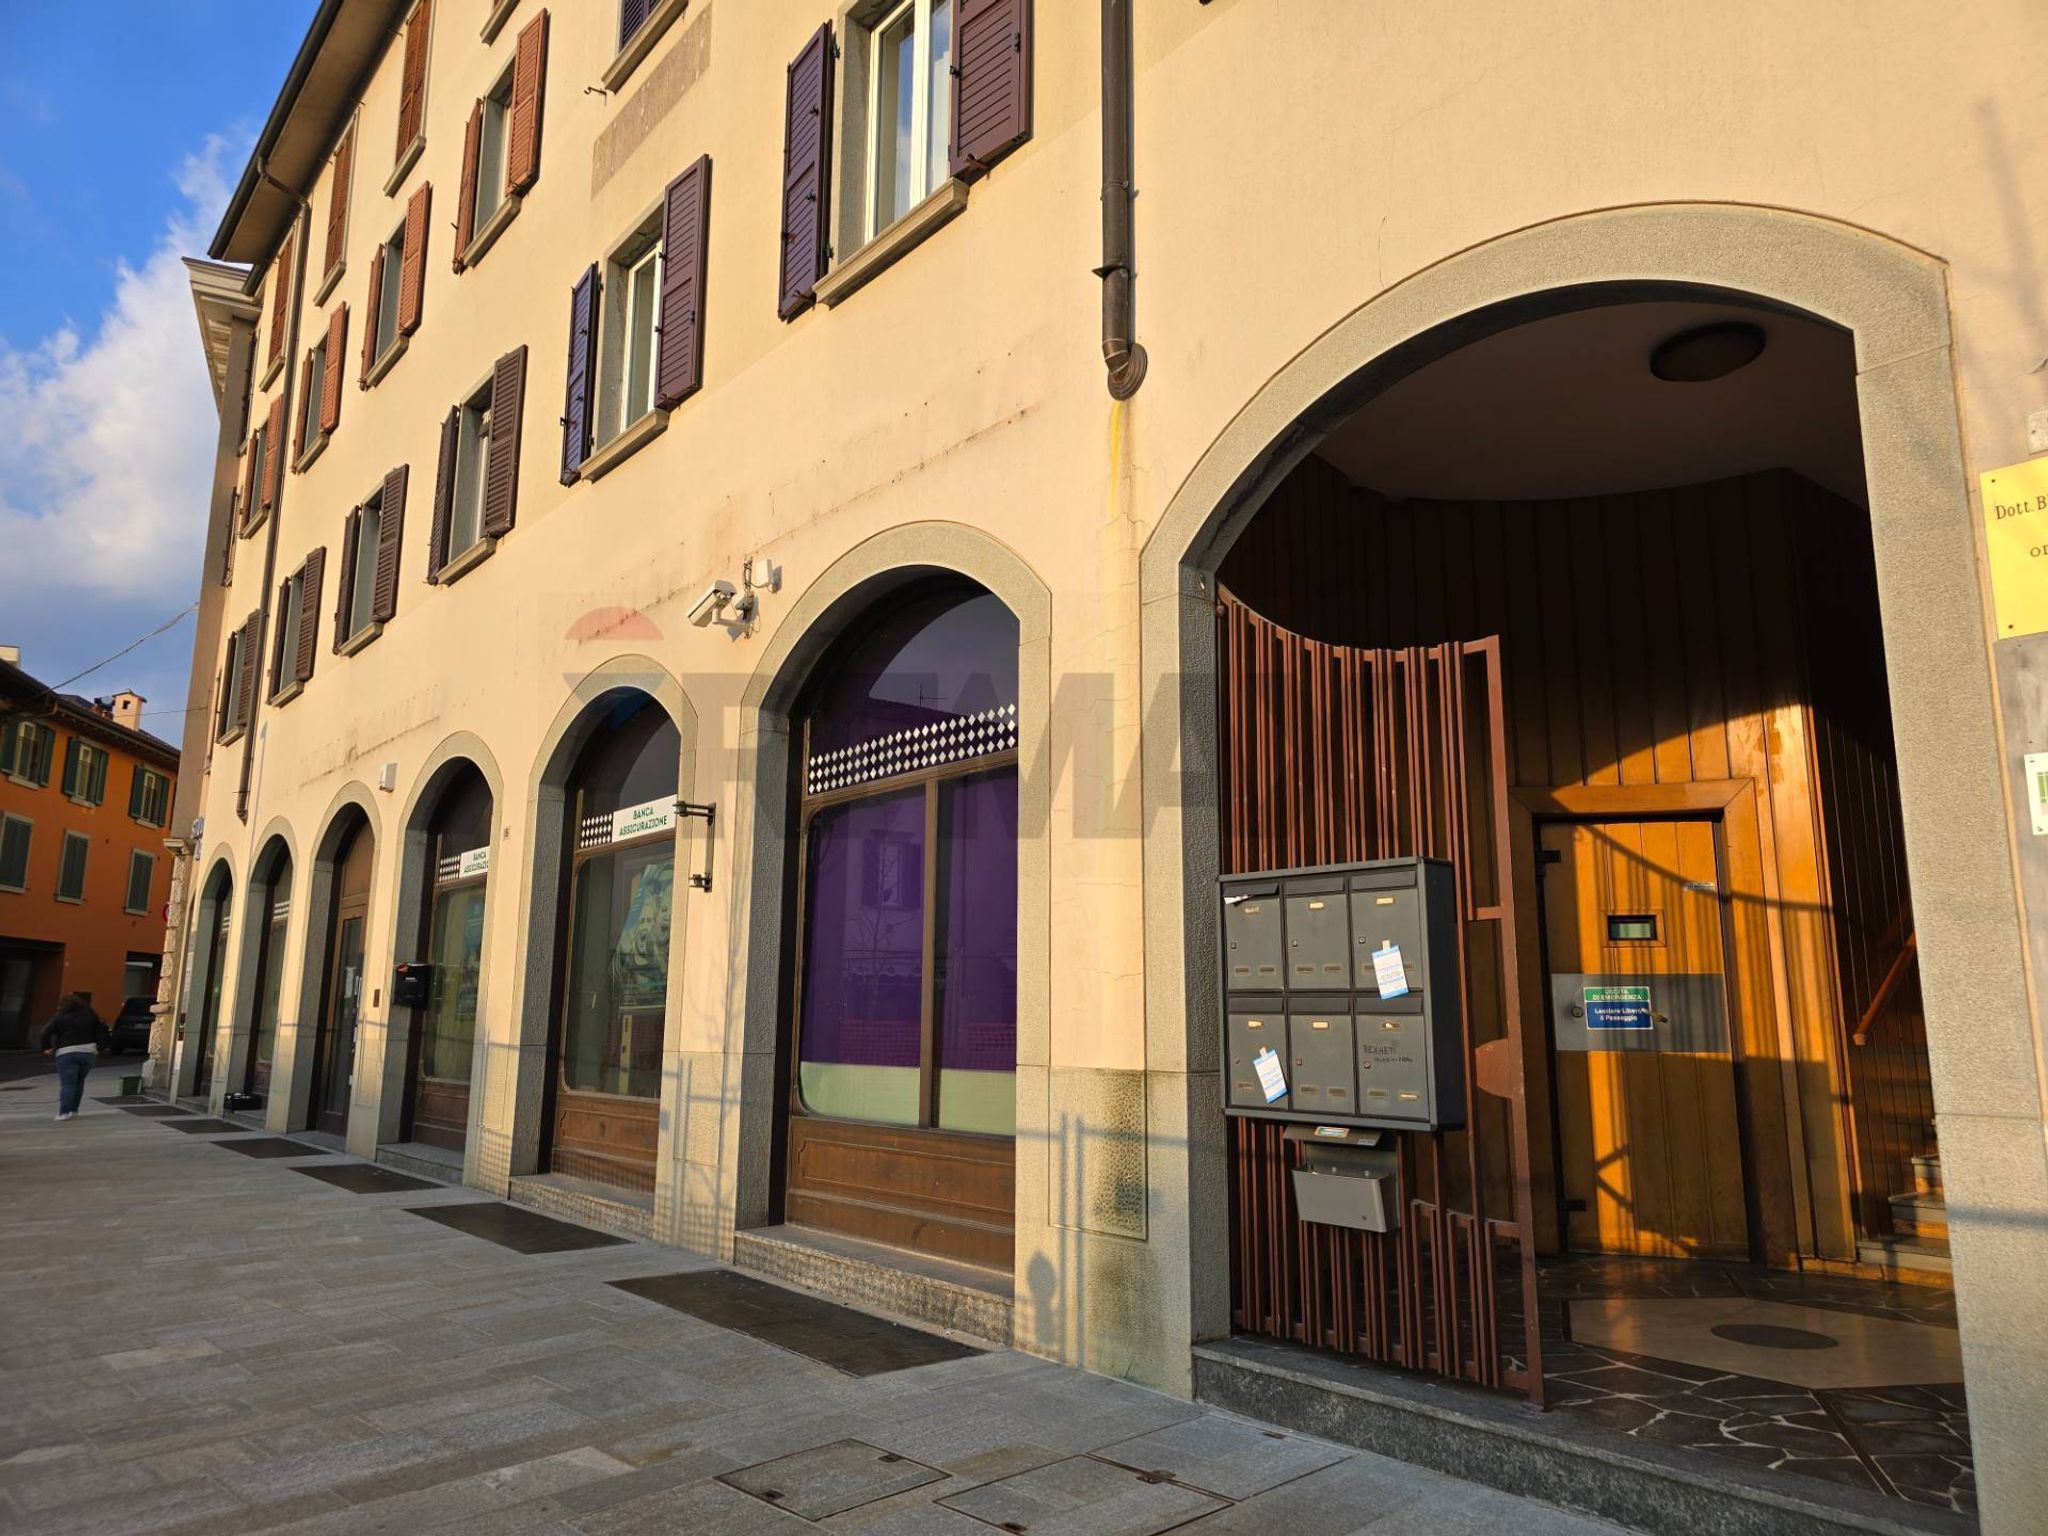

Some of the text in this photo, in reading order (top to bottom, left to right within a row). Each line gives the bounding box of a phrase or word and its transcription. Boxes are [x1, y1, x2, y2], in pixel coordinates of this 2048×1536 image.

[2037, 495, 2048, 510] B
[633, 807, 654, 820] BANCA
[619, 815, 667, 836] ASSICURAZIONE
